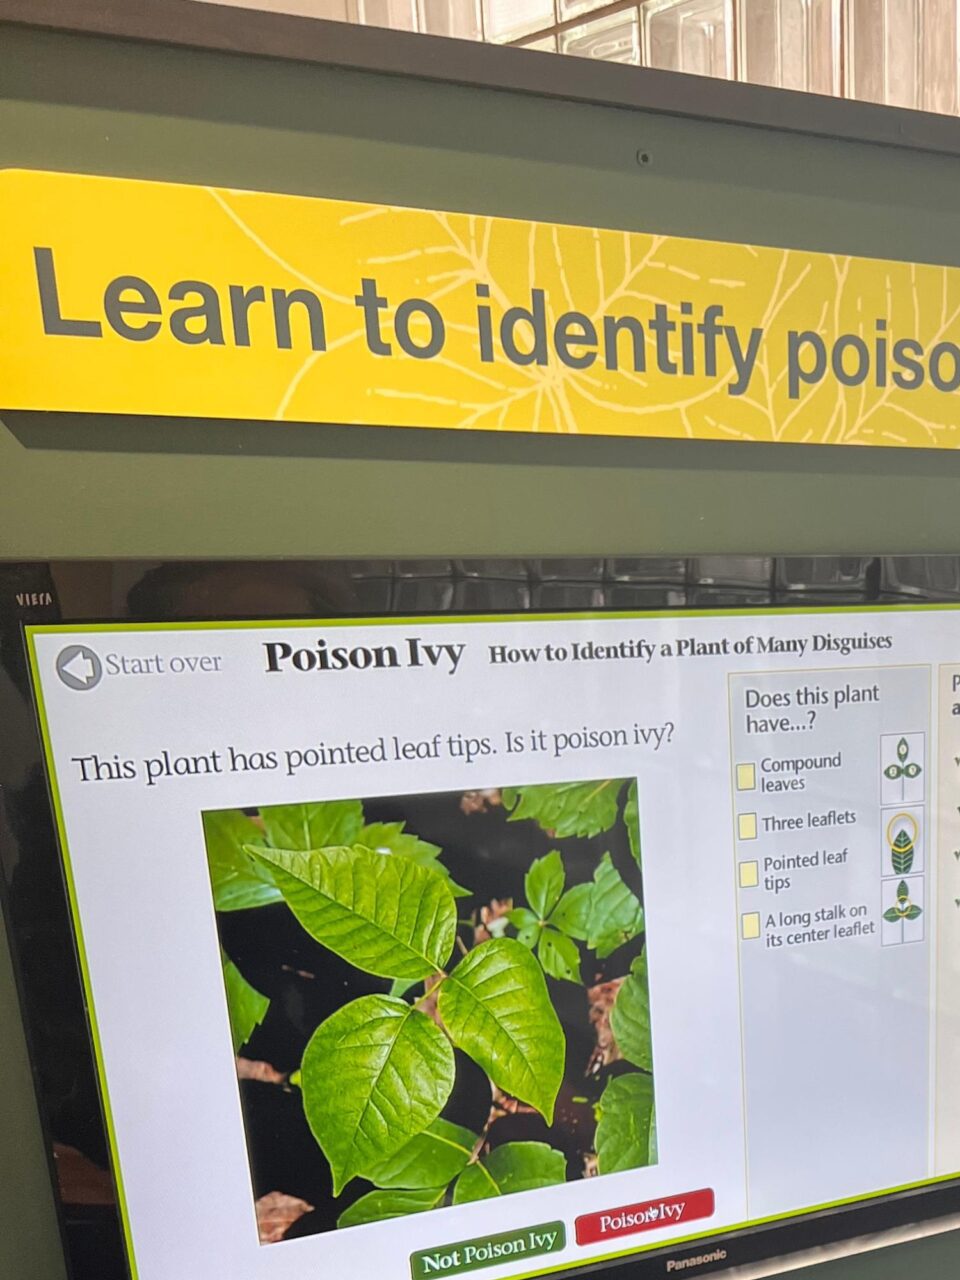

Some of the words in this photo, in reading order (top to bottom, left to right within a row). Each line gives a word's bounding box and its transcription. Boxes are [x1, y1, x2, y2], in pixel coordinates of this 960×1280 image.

[33, 245, 327, 351] Learn
[354, 278, 446, 360] to
[477, 290, 763, 397] identify
[263, 639, 401, 673] Poison
[405, 637, 466, 674] Ivy
[488, 645, 541, 664] How
[544, 644, 567, 662] to
[571, 639, 656, 663] Identify
[660, 643, 673, 657] a
[676, 636, 730, 657] Plant
[733, 636, 756, 654] of
[757, 635, 808, 657] Many
[812, 633, 893, 655] Disguises
[106, 653, 163, 676] Start
[169, 654, 222, 674] over
[745, 689, 791, 709] Does
[796, 686, 829, 707] this
[834, 684, 880, 709] plant
[746, 711, 816, 734] have...?
[71, 755, 136, 783] This
[143, 749, 222, 786] plant
[229, 747, 278, 773] has
[285, 738, 386, 776] pointed
[392, 734, 442, 761] leaf
[446, 734, 498, 767] tips.
[505, 731, 524, 753] Is
[530, 728, 547, 751] it
[553, 725, 628, 758] poison
[633, 722, 675, 750] ivy?
[761, 752, 841, 775] Compound
[761, 776, 805, 793] leaves
[762, 816, 804, 833] Three
[807, 810, 856, 827] leaflets
[764, 853, 819, 872] Pointed
[822, 848, 848, 865] leaf
[764, 876, 791, 894] tips
[765, 914, 776, 928] A
[778, 910, 811, 930] long
[814, 904, 846, 922] stalk
[850, 905, 867, 918] on
[766, 932, 783, 948] its
[787, 928, 830, 945] center
[834, 920, 875, 939] leaflet
[659, 1202, 685, 1220] Ivy
[421, 1251, 460, 1274] Not
[463, 1238, 525, 1267] Poison
[528, 1230, 559, 1256] Ivy
[666, 1248, 727, 1273] Panasonic
